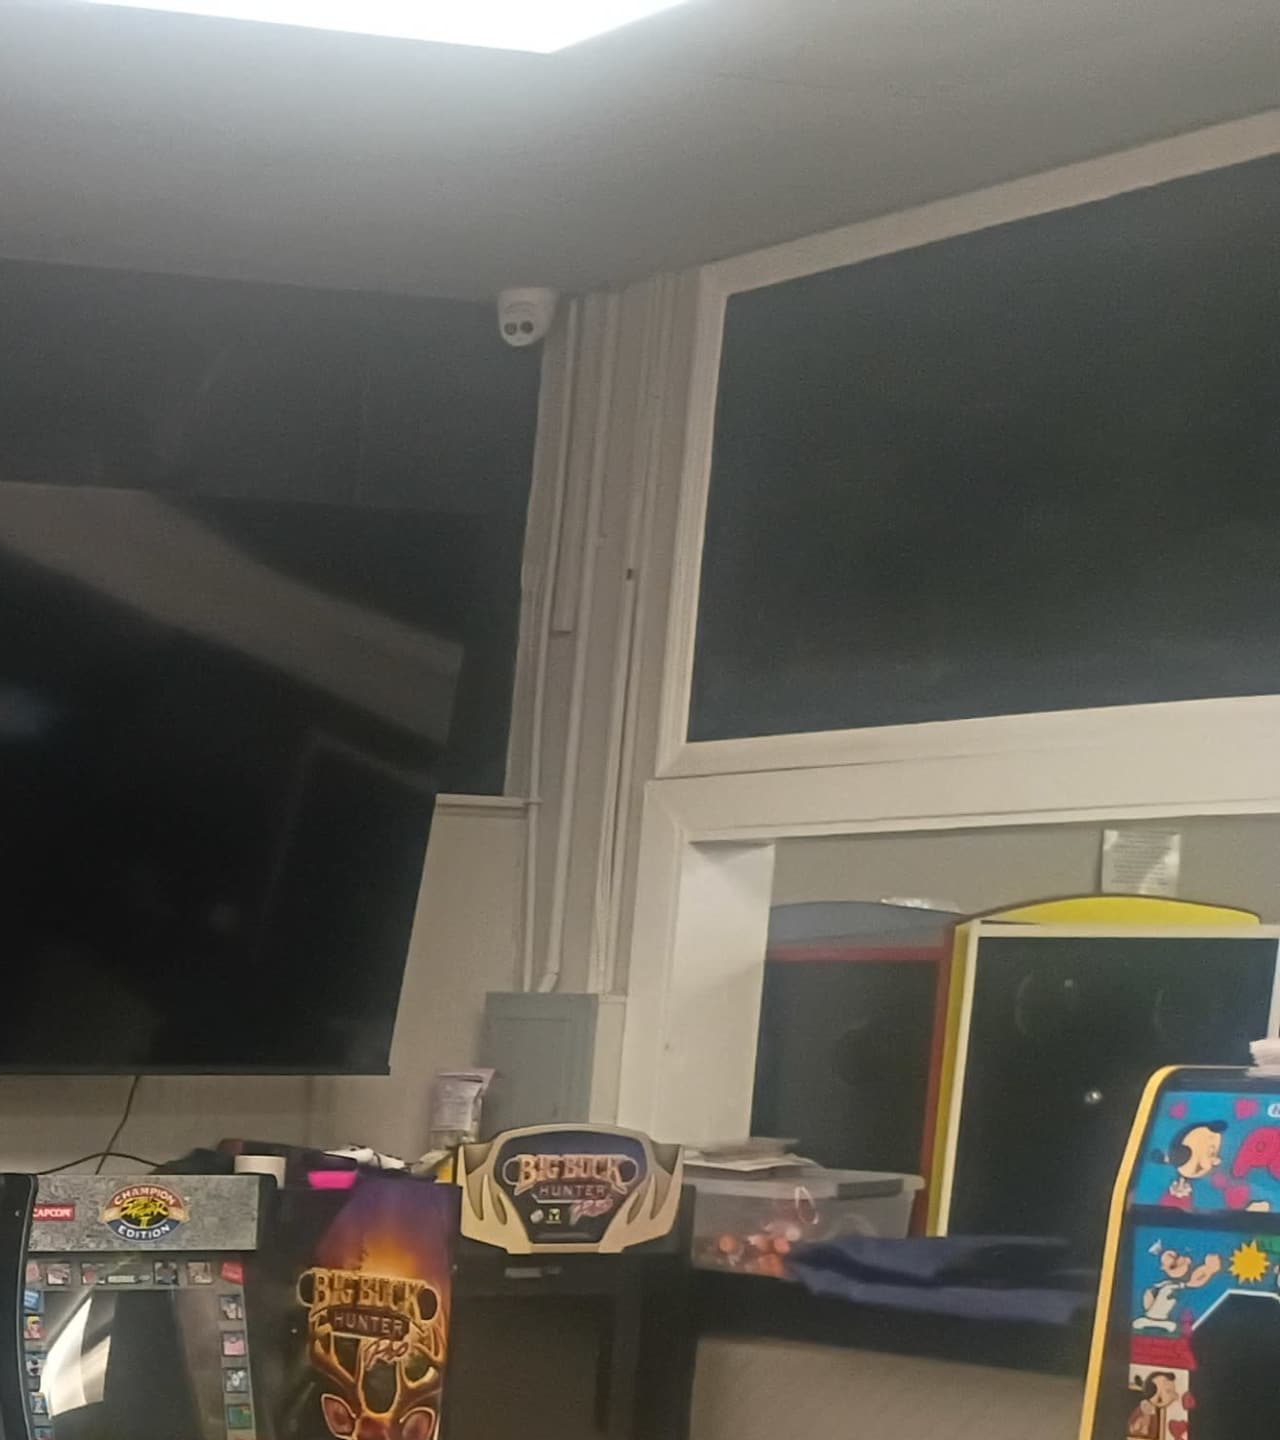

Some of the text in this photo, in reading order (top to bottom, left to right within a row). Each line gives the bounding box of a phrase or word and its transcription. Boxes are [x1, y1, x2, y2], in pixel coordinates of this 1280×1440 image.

[517, 1154, 626, 1188] BIG BUCK
[113, 1186, 177, 1206] CHAMPION
[540, 1184, 607, 1198] HUNTER
[32, 1207, 73, 1218] CAPCOM
[117, 1223, 171, 1240] EDITION
[312, 1267, 423, 1320] BIG BUCK
[333, 1310, 404, 1340] HUNTER
